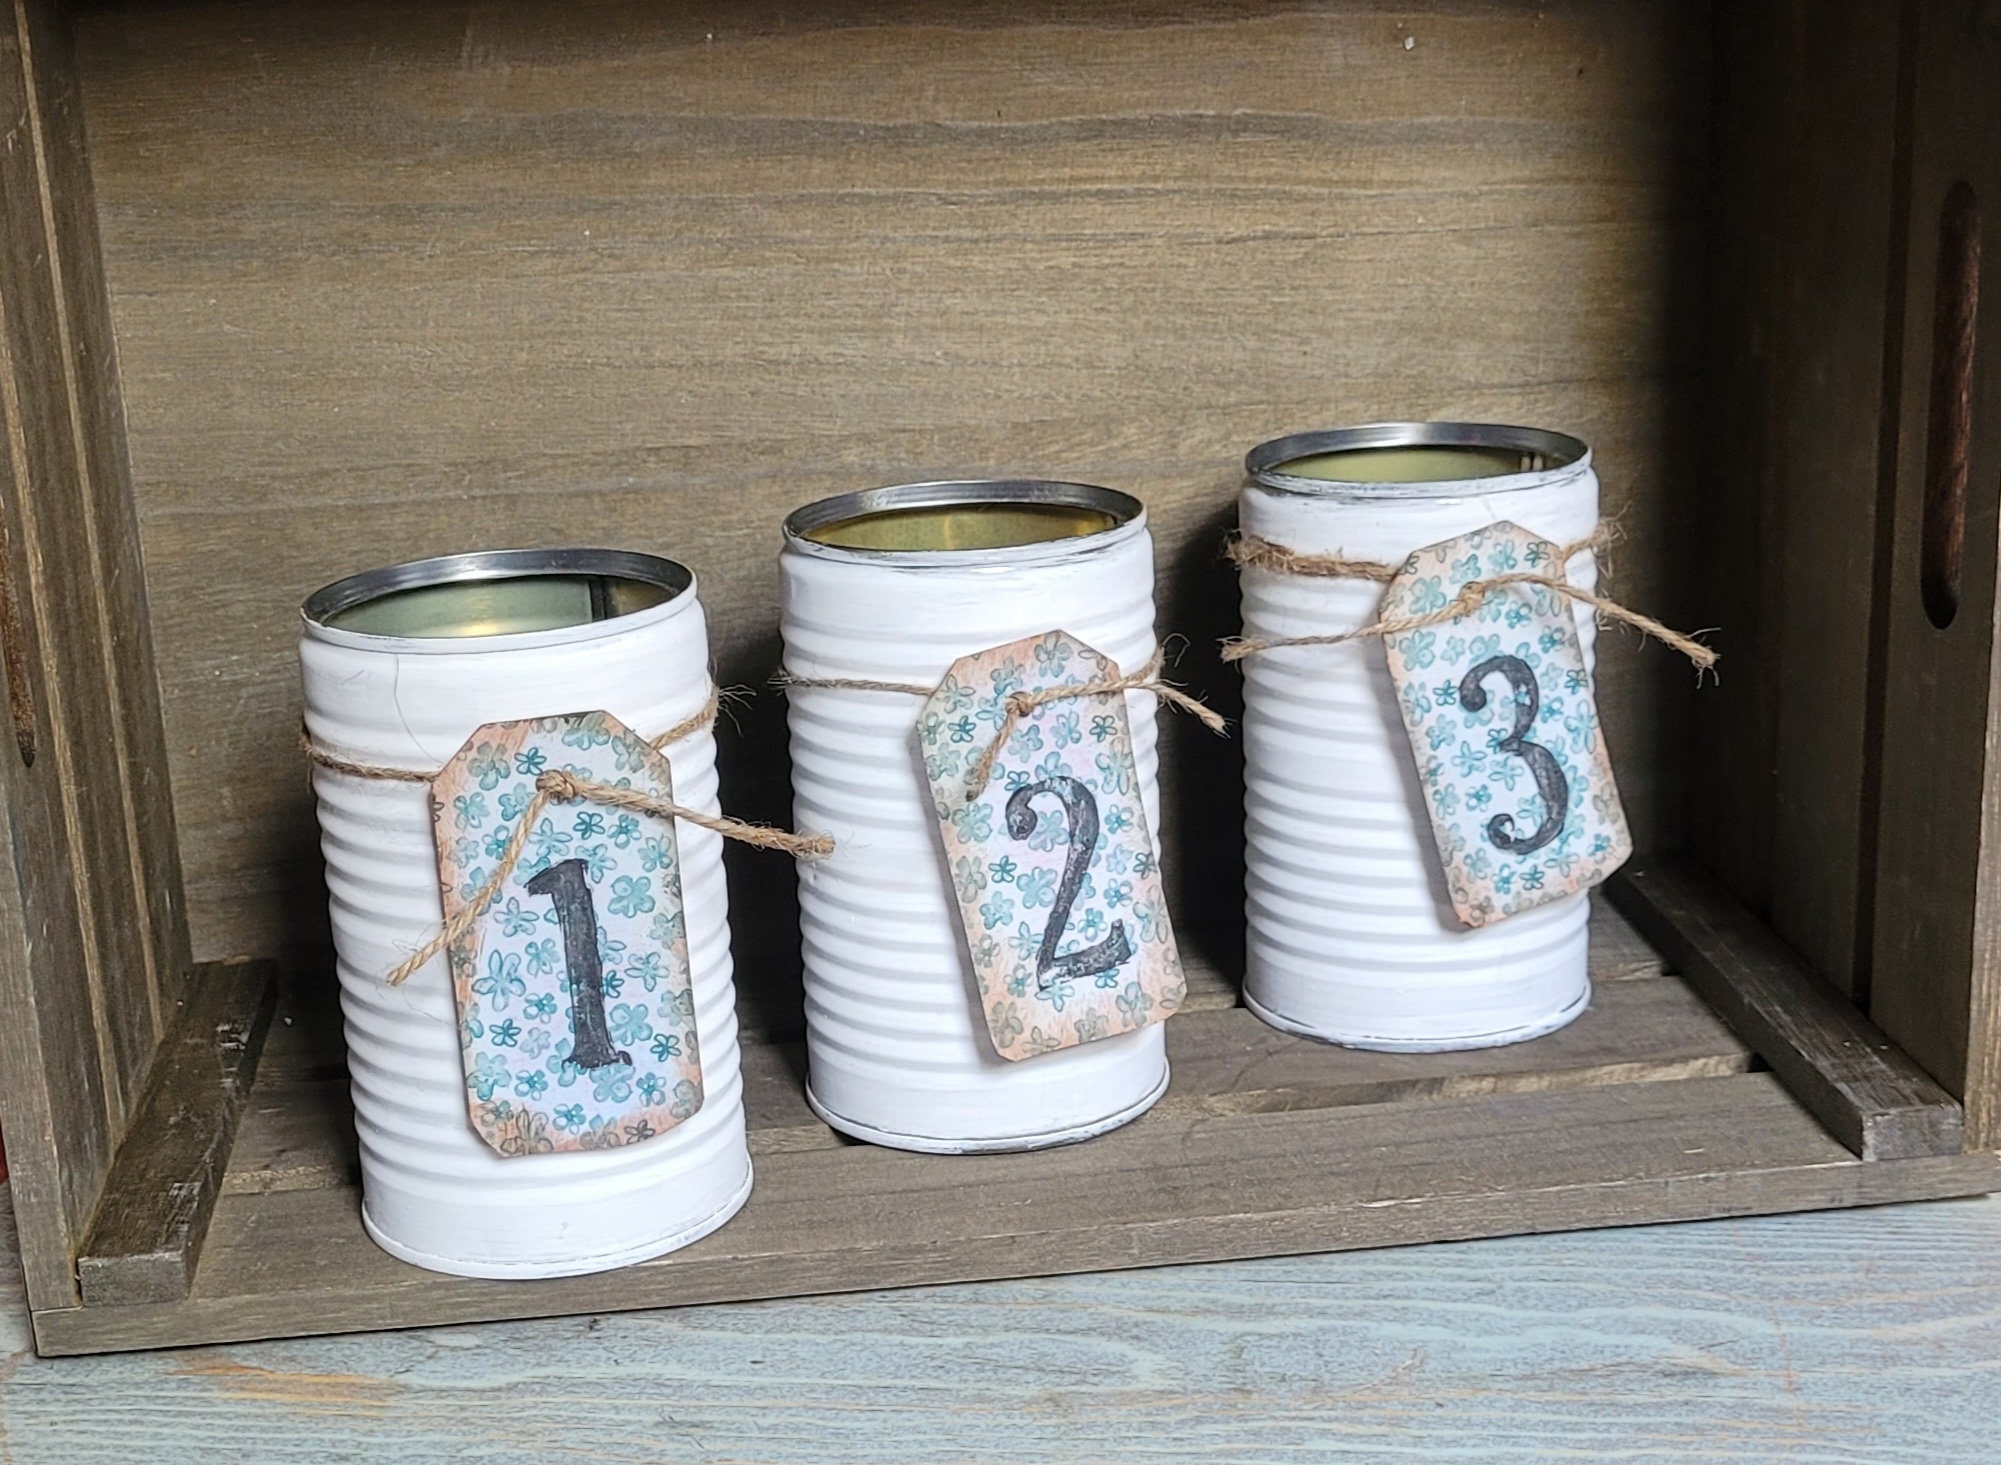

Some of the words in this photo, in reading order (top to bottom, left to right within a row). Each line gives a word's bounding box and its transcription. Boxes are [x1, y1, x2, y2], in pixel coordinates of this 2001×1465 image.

[1460, 655, 1568, 855] 3
[525, 858, 632, 1069] 1
[1005, 775, 1130, 990] 2
